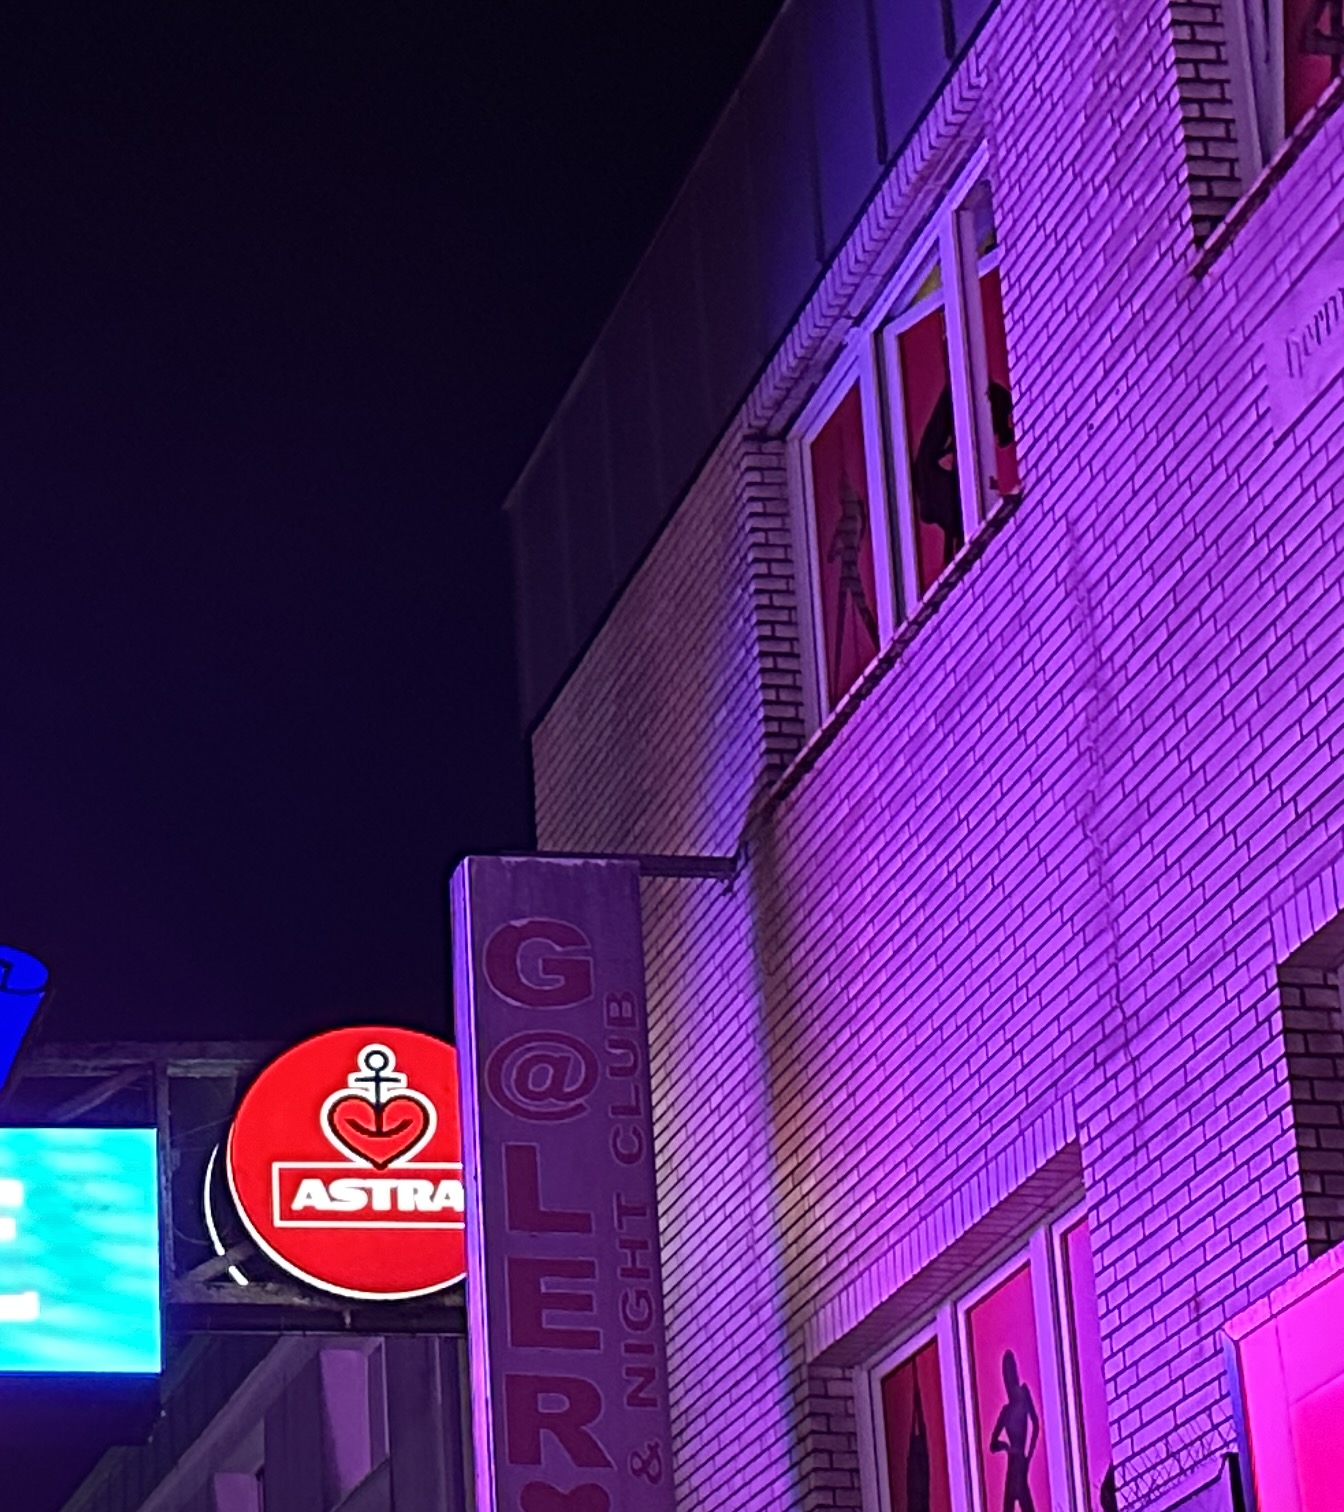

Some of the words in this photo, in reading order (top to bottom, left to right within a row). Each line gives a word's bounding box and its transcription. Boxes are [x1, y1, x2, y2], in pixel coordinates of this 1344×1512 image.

[605, 989, 647, 1167] CLUB
[290, 1177, 465, 1212] ASTRA
[614, 1191, 658, 1410] NIGHT
[629, 1439, 664, 1486] &
